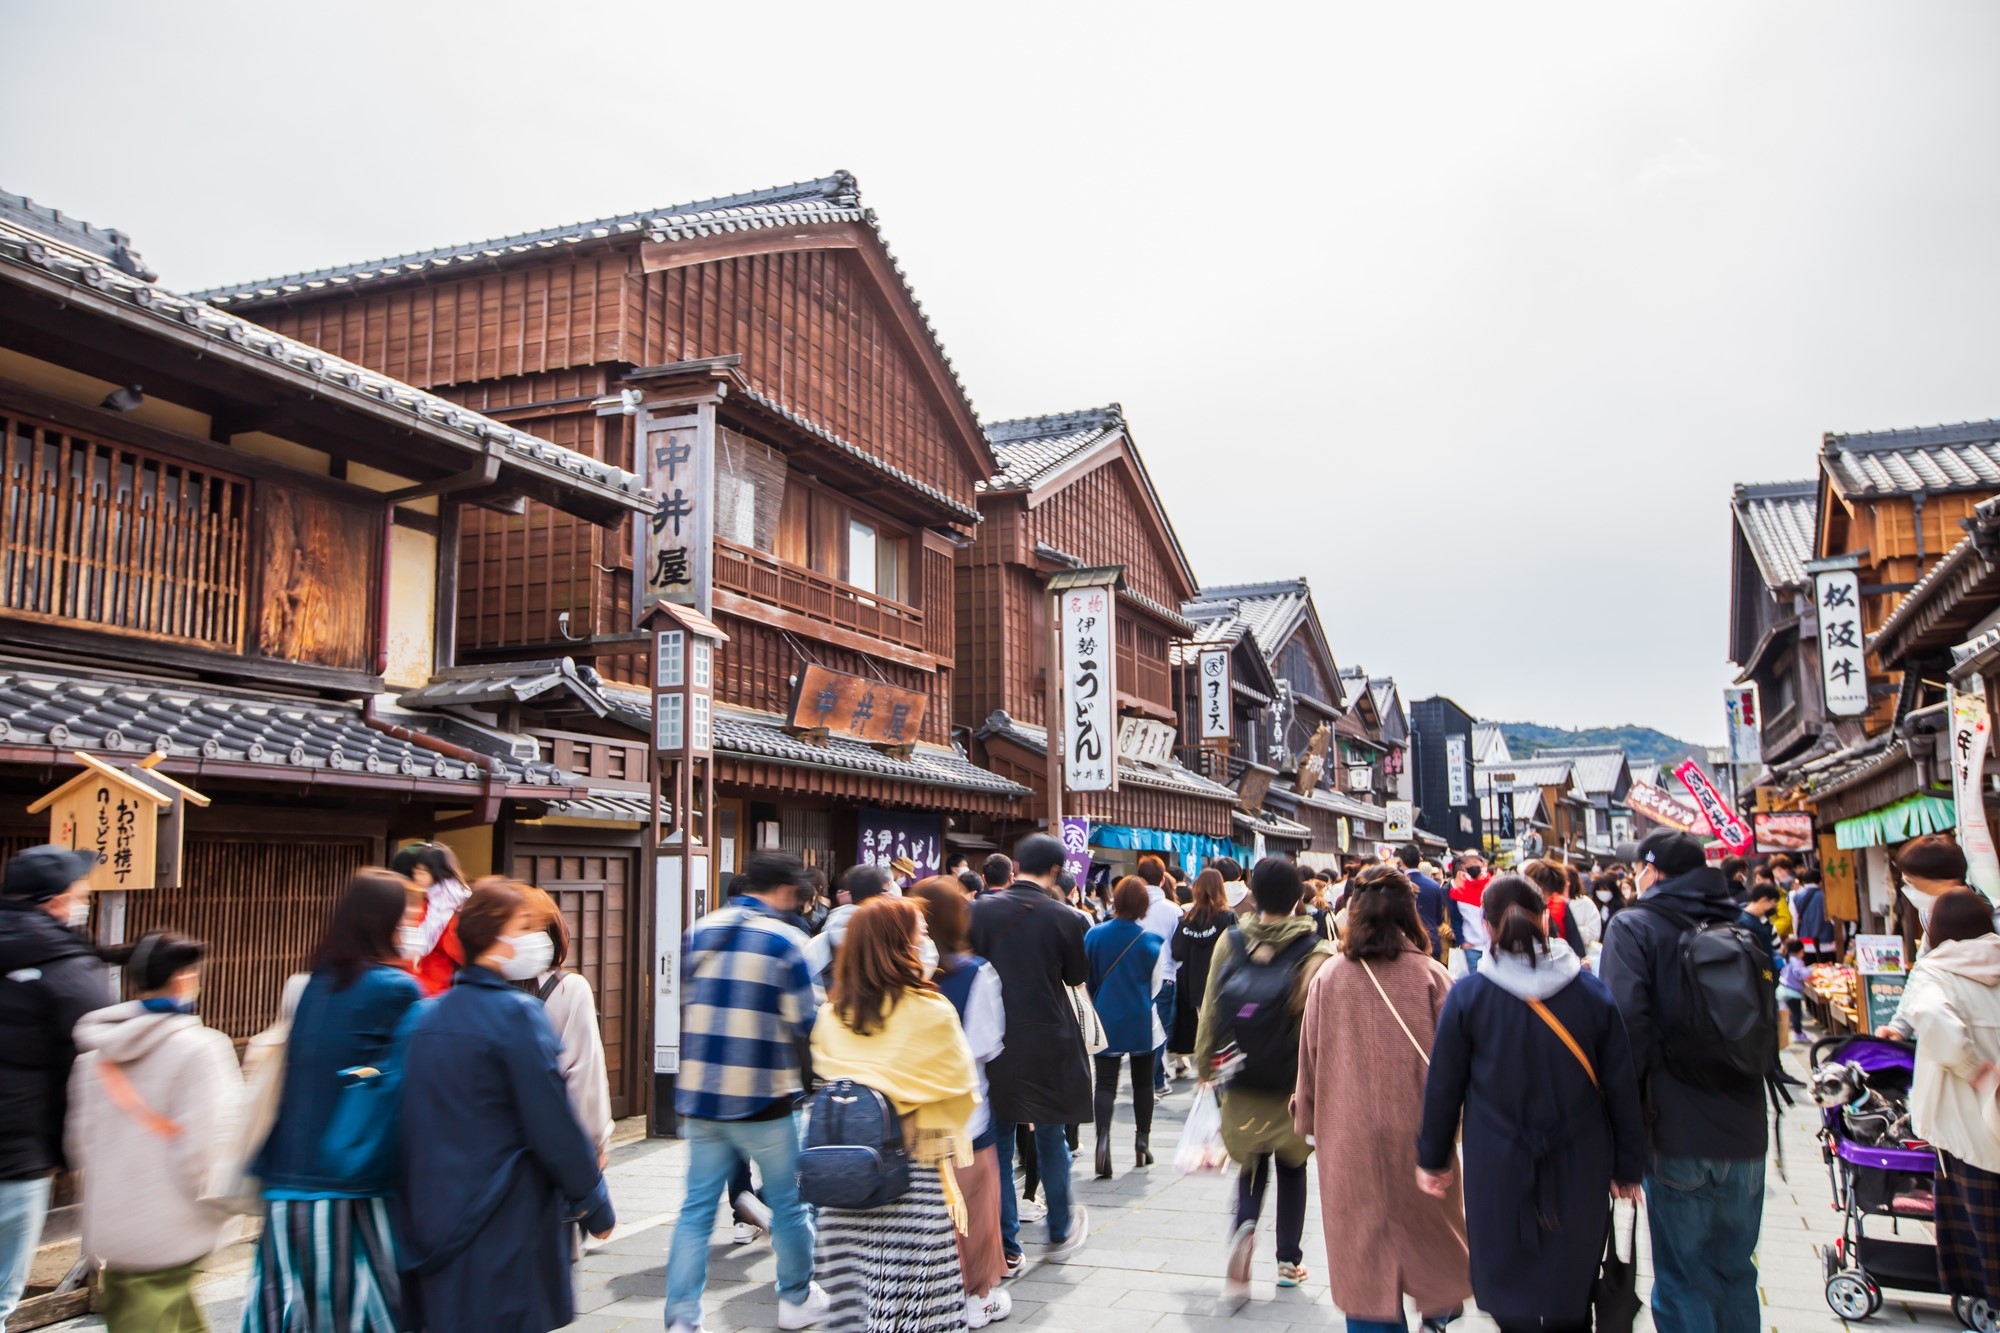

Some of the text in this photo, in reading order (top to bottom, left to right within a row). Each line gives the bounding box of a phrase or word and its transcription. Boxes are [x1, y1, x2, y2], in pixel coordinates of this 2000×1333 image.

[649, 435, 693, 589] 中井屋
[1067, 595, 1104, 614] 名物
[1823, 582, 1860, 687] 松阪牛
[816, 682, 910, 741] 中井屋
[1075, 616, 1102, 764] 伊勢うどん
[1207, 680, 1226, 731] まる天
[1071, 769, 1106, 781] 中井屋
[113, 798, 139, 884] おかげ横丁
